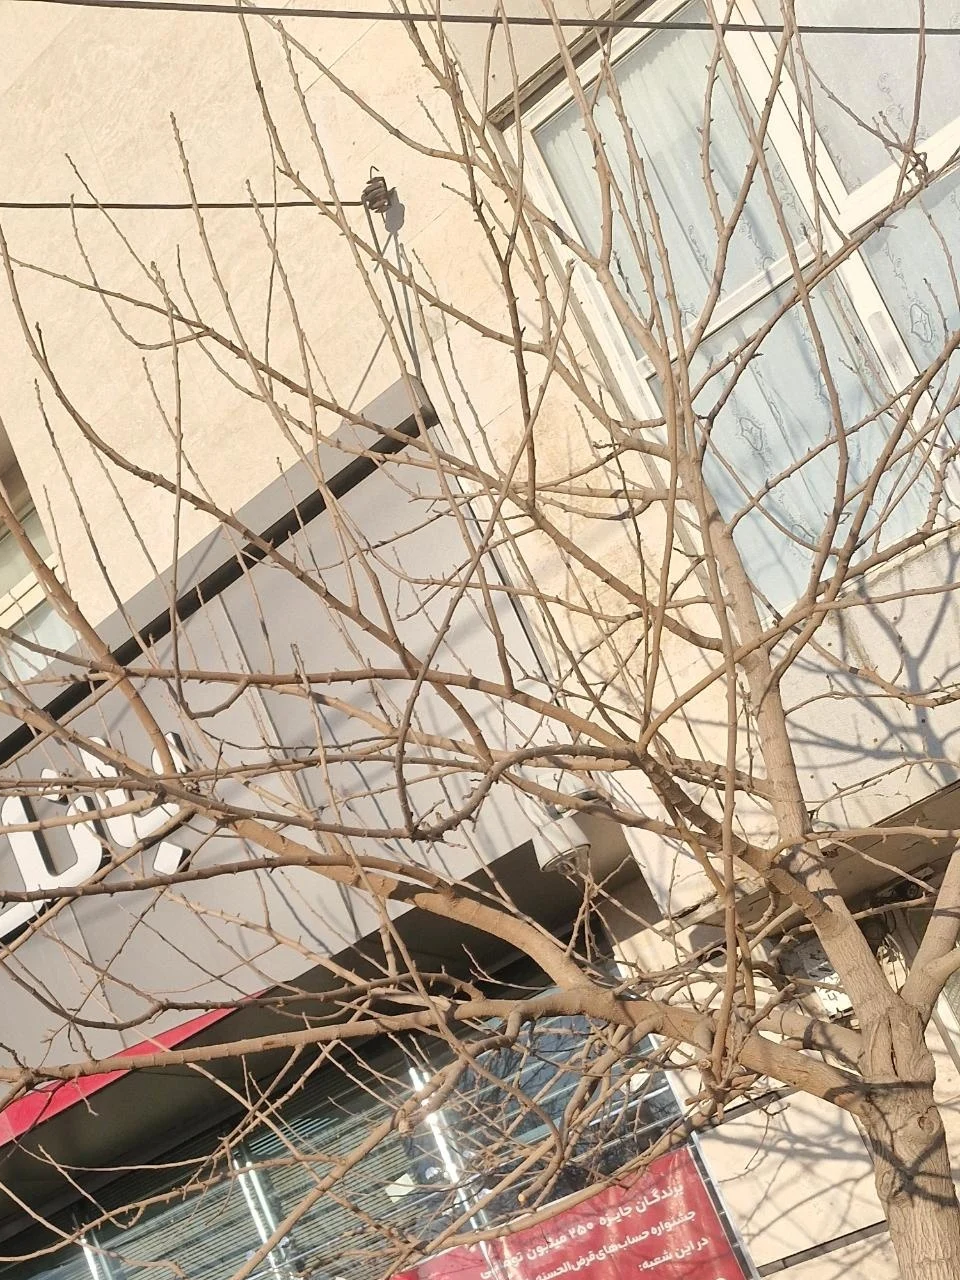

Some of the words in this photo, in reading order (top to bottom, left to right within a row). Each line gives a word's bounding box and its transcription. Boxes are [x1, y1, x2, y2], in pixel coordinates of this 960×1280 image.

[635, 1181, 685, 1214] برندگان
[598, 1204, 634, 1229] جایزه
[650, 1208, 697, 1238] جشنواره
[569, 1220, 595, 1241] ۲۵۰
[674, 1241, 692, 1260] این
[691, 1236, 710, 1253] در
